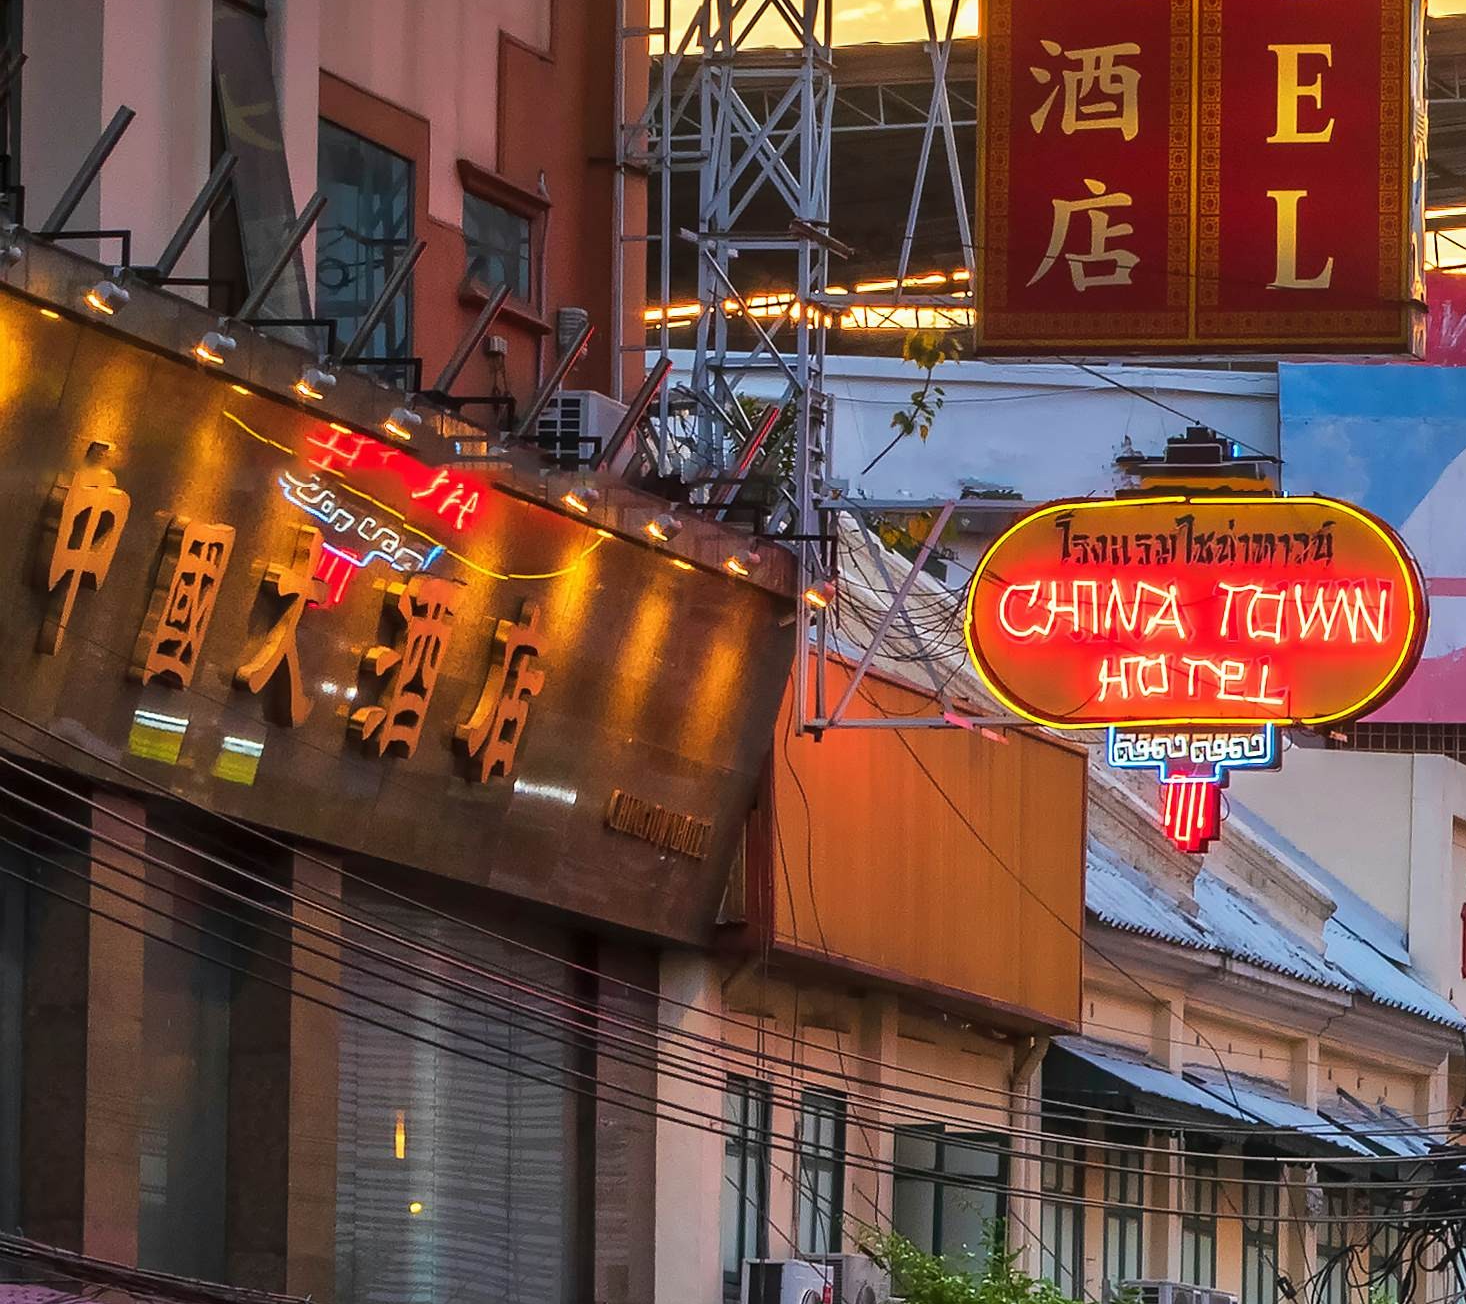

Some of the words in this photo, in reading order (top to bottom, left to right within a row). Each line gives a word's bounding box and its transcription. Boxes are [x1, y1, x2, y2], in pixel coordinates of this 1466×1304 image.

[40, 442, 547, 787] 中國大酒店
[999, 577, 1187, 639] CHINA
[1218, 577, 1391, 645] TOWN
[1098, 653, 1286, 707] HOTEL
